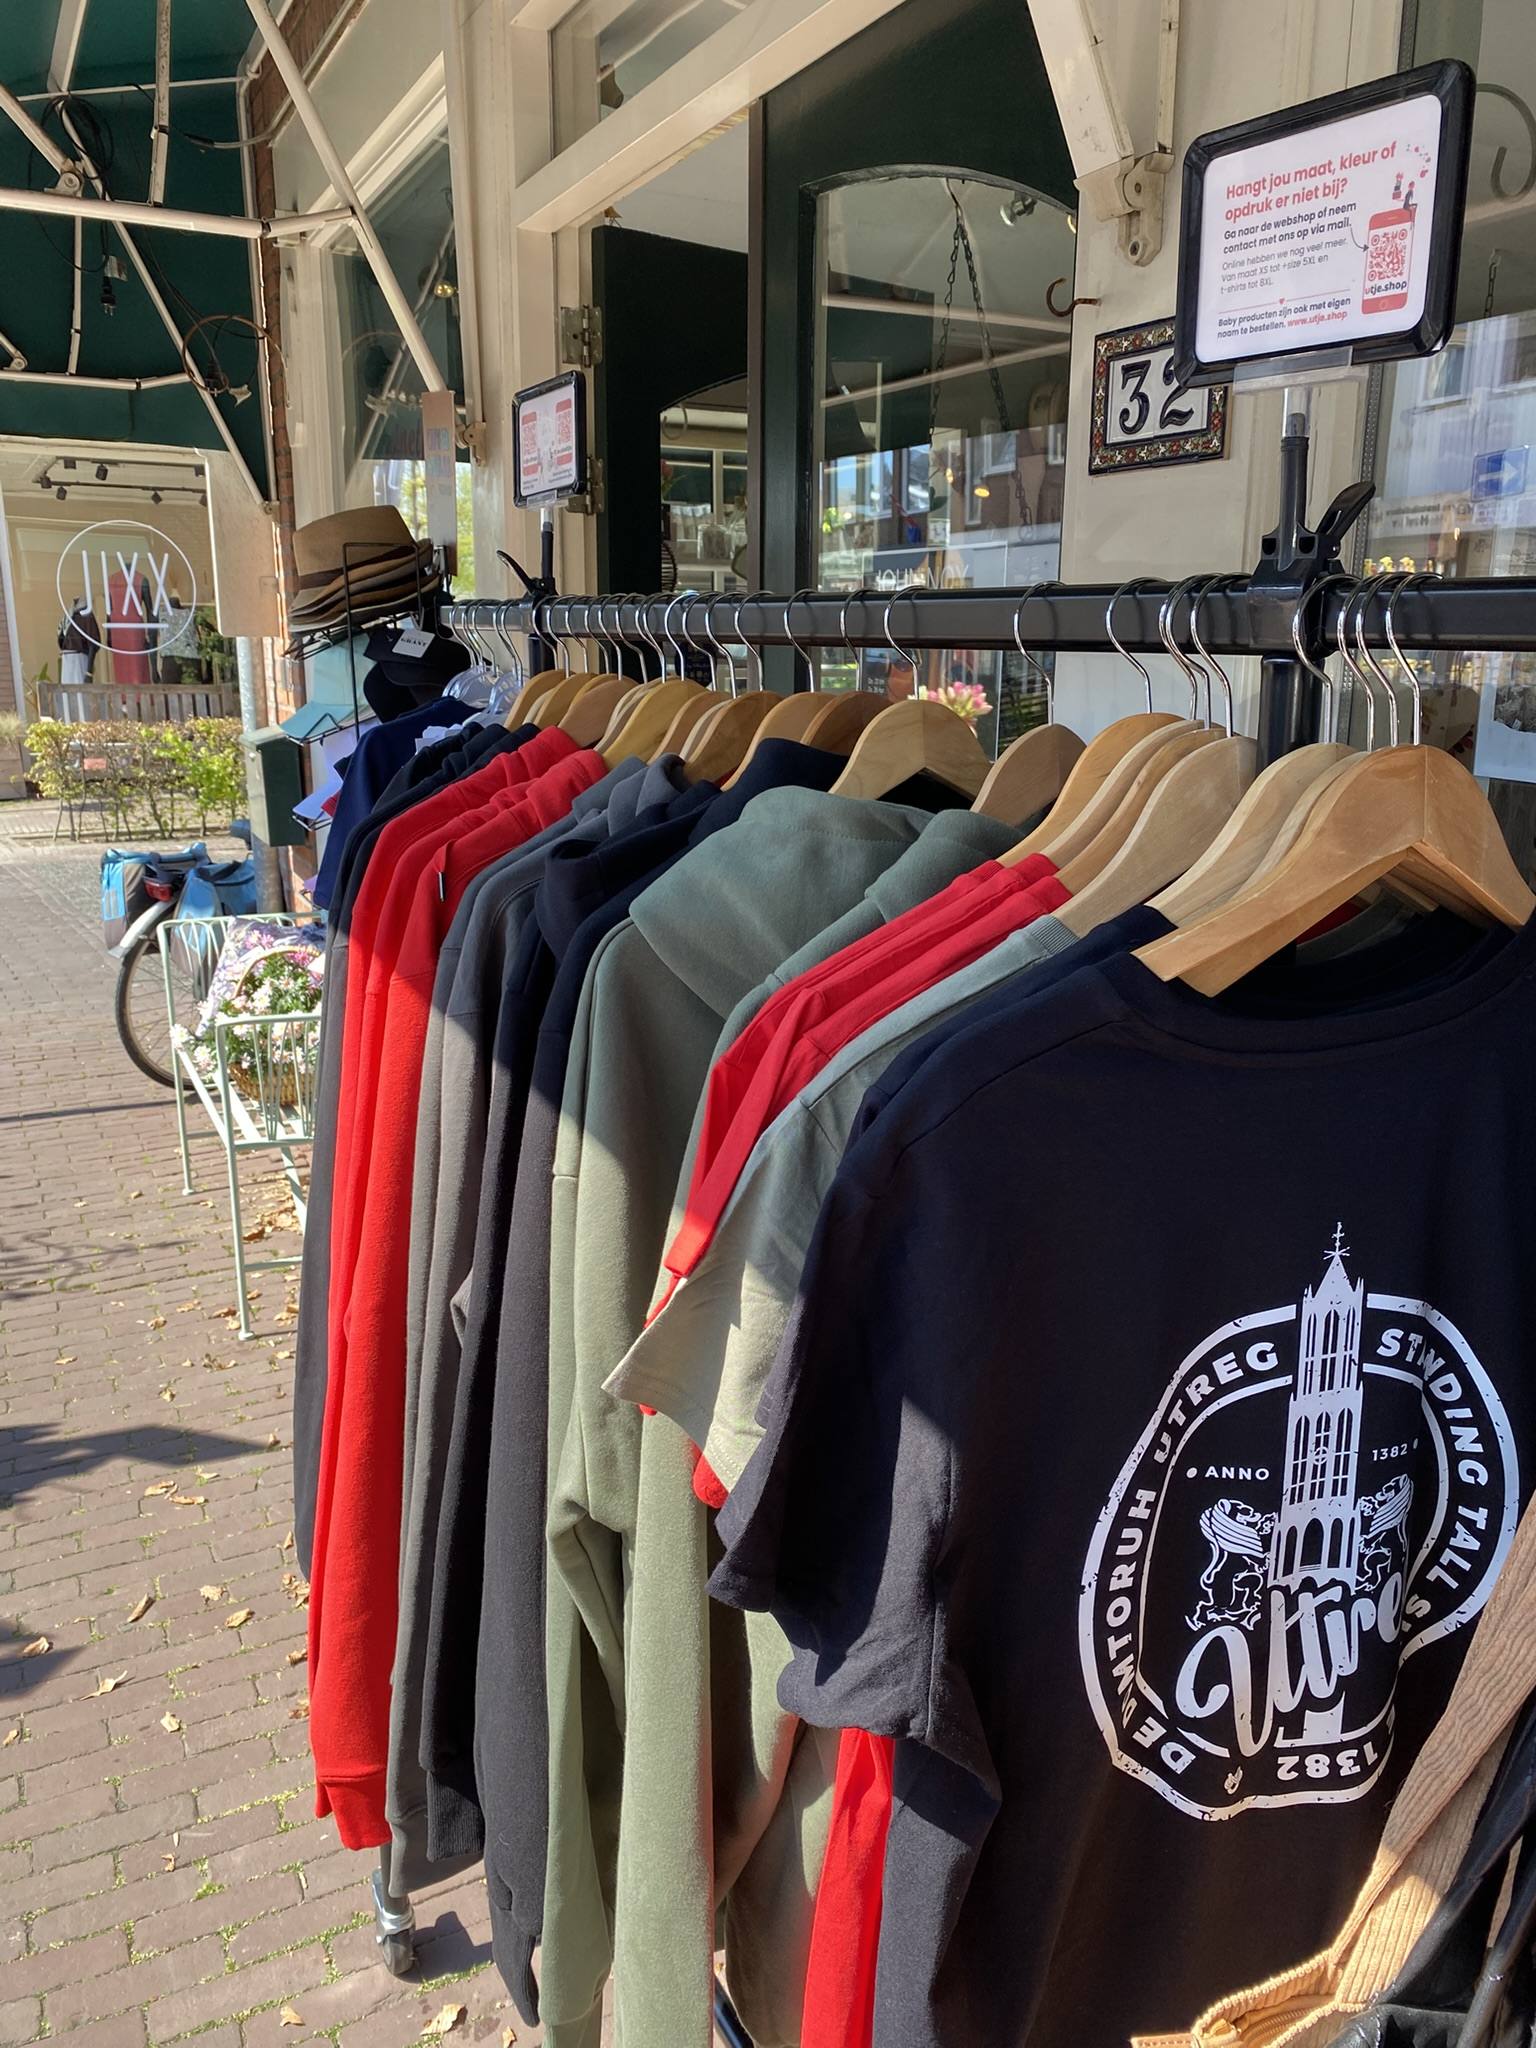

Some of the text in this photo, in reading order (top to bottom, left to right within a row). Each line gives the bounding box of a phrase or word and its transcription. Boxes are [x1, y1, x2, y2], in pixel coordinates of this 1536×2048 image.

[1226, 141, 1397, 199] Hangt jou maat, kleur of
[1225, 178, 1348, 223] opdruk er niet bij?
[1223, 217, 1352, 254] contact met ons op via mail.
[1224, 202, 1357, 240] Ga naar de webshop of neem
[1221, 254, 1329, 282] Van maat XS tot +size 5XL en
[1222, 258, 1245, 271] Online
[1246, 253, 1276, 266] hebben
[1277, 250, 1288, 259] we
[1289, 247, 1305, 258] nog
[1306, 242, 1324, 253] veel
[1220, 282, 1247, 295] t-shirts
[1247, 280, 1258, 289] tot
[1364, 280, 1407, 296] utje.shop
[1217, 310, 1348, 339] naam te bestellen. www.utje.shop
[1218, 297, 1351, 328] Baby producten zijn ook met eigen
[1119, 356, 1194, 435] 32
[79, 550, 173, 617] JIXX
[1372, 1443, 1408, 1461] 1382
[1205, 1466, 1270, 1481] ANNO
[1105, 1342, 1279, 1775] DE DMTORUH UTREG
[1425, 1504, 1489, 1590] TALL
[1176, 1572, 1402, 1757] Utre
[1277, 1741, 1379, 1781] 1382
